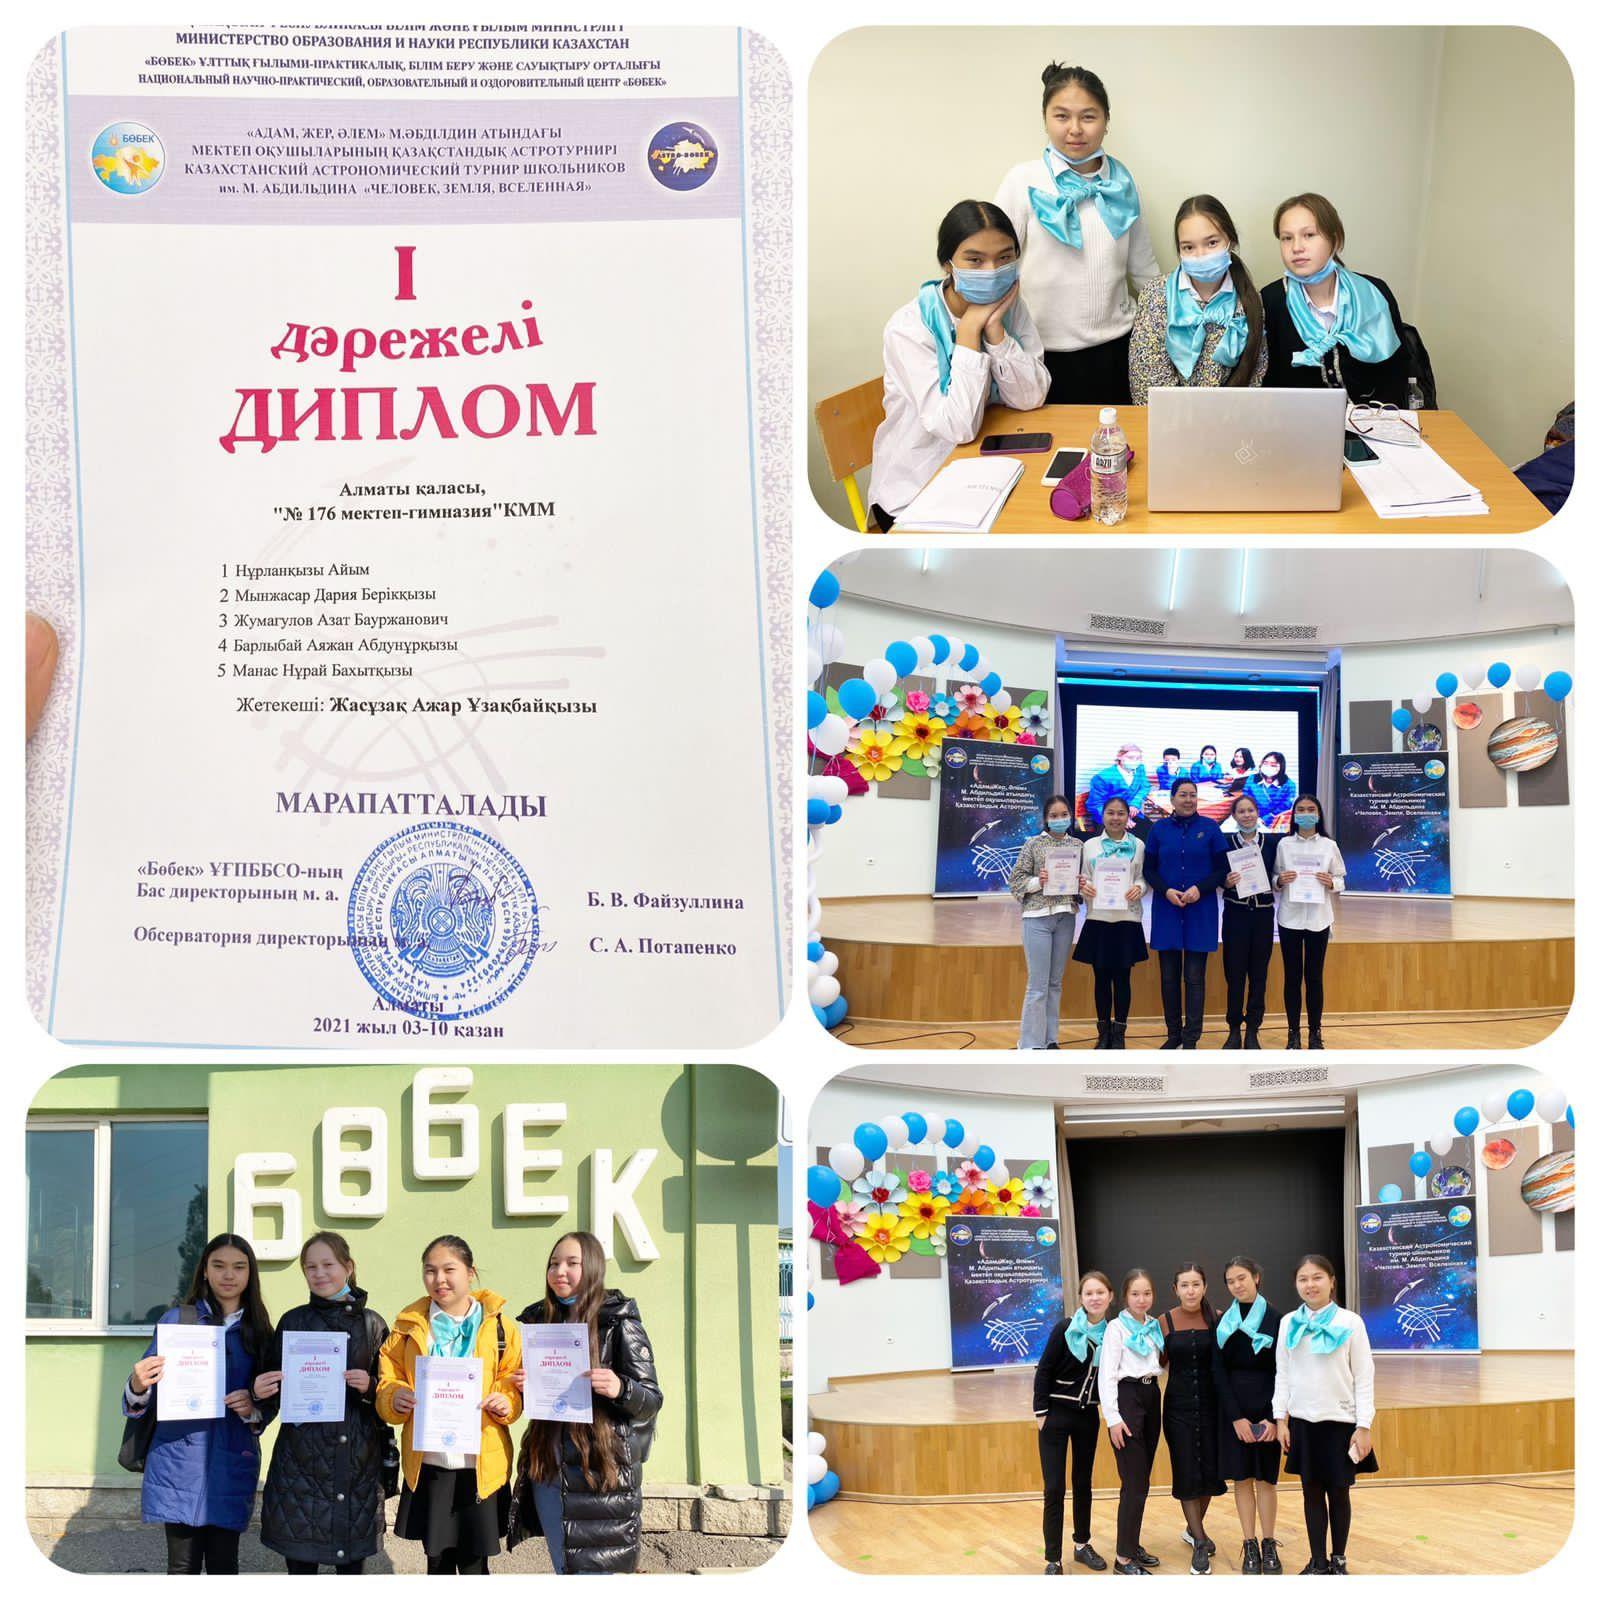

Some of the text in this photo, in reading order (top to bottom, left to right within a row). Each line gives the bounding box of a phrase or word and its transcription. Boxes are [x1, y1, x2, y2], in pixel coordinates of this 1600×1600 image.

[176, 33, 629, 49] МИНИСТЕРСТВО ОБРАЗОВАНИЯ И НАУКИ РЕСПУБЛИКИ КАЗАХСТАН
[145, 57, 660, 71] «БӨБЕК» ҰЛТТЫҚ ҒЫЛЫМИ-ПРАКТИКАЛЫҚ, БІЛІМ БЕРУ ЖӘНЕ САУЫҚТЫРУ ОРТАЛЫҒЫ
[139, 74, 666, 88] НАЦИОНАЛЬНЫЙ НАУЧНО-ПРАКТИЧЕСКИЙ, ОБРАЗОВАТЕЛЬНЫЙ И ОЗДОРОВИТЕЛЬНЫЙ ЦЕНТР «БӨБЕК»
[122, 134, 155, 144] БӨБЕК
[248, 128, 298, 139] «АДАМ,
[302, 128, 334, 139] ЖЕР,
[338, 129, 385, 139] ӘЛЕМ»
[482, 128, 561, 139] АТЫНДАҒЫ
[193, 145, 616, 158] МЕКТЕП ОҚУШЫЛАРЫНЫҢ ҚАЗАҚСТАНДЫҚ АСТРОТУРНИРІ
[185, 163, 625, 175] КАЗАХСТАНСКИЙ АСТРОНОМИЧЕСКИЙ ТУРНИР ШКОЛЬНИКОВ
[244, 183, 258, 193] М.
[263, 184, 356, 195] АБДИЛЬДИНА
[365, 184, 440, 194] «ЧЕЛОВЕК,
[444, 183, 495, 193] ЗЕМЛЯ,
[499, 182, 591, 192] ВСЕЛЕННАЯ»
[269, 300, 545, 373] дәрежелі
[219, 382, 597, 453] ДИПЛОМ
[340, 484, 485, 496] Алматы қаласы,
[310, 506, 336, 520] 176
[223, 564, 369, 580] 1 Нұрланқызы Айым
[220, 588, 435, 604] 2 Мынжасар Дария Берікқызы
[219, 613, 447, 629] 3 Жумагулов Азат Бауржанович
[218, 639, 457, 654] 4 Барлыбай Аяжан Абдунұрқызы
[218, 664, 412, 679] 5 Манас Нұрай Бахытқызы
[237, 697, 596, 716] Жетекеші: Жасұзақ Ажар Ұзақбайқызы
[276, 791, 547, 821] МАРАПАТТАЛАДЫ
[138, 861, 342, 878] «Бөбек» ҰҒПББСО-ның
[138, 883, 338, 903] Бас директорының м. а.
[588, 892, 743, 912] Б. В. Файзуллина
[134, 927, 253, 946] Обсерватория
[590, 937, 736, 954] С. А. Потапенко
[314, 1018, 505, 1038] 2021 жыл 03-10 қазан
